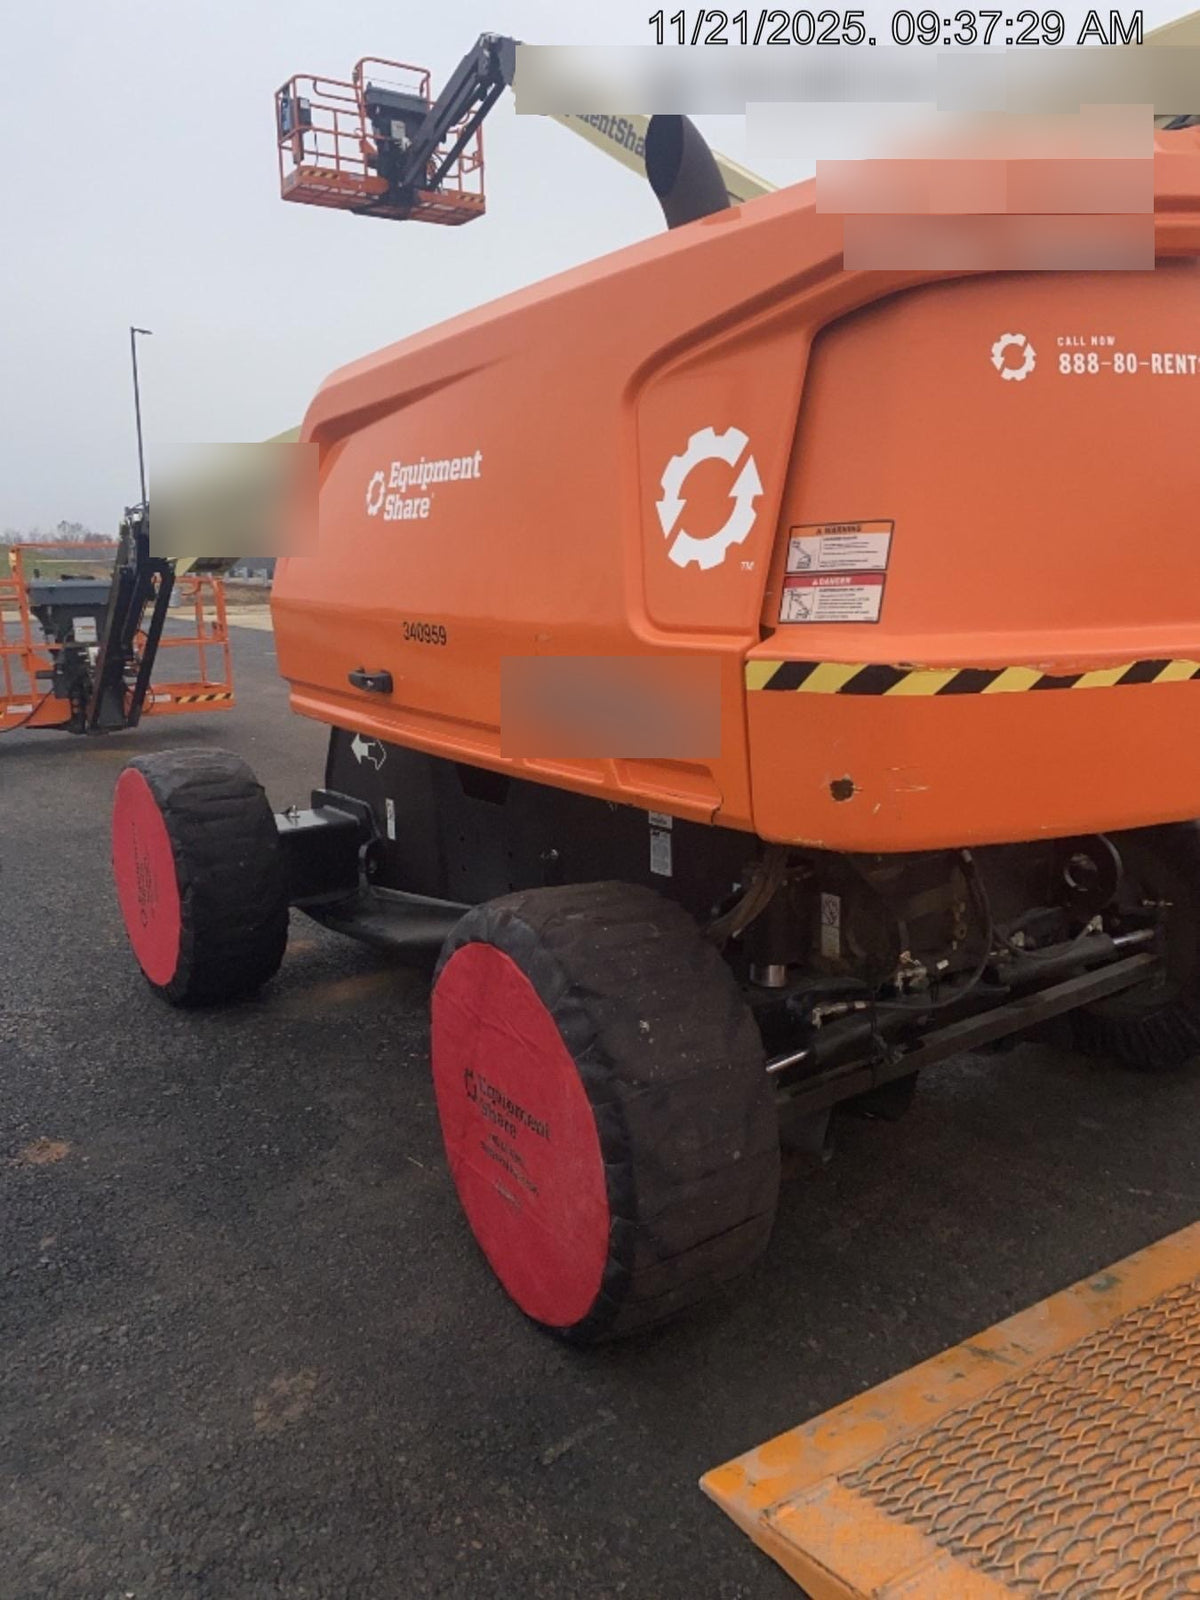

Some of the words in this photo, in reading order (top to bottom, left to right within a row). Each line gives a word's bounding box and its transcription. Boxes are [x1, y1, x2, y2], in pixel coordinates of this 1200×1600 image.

[1057, 336, 1086, 347] CALL
[1091, 335, 1116, 347] NOW
[1059, 352, 1200, 375] 888-80-RENT
[388, 450, 483, 493] Equipment
[383, 494, 430, 521] Share
[402, 621, 447, 646] 340959
